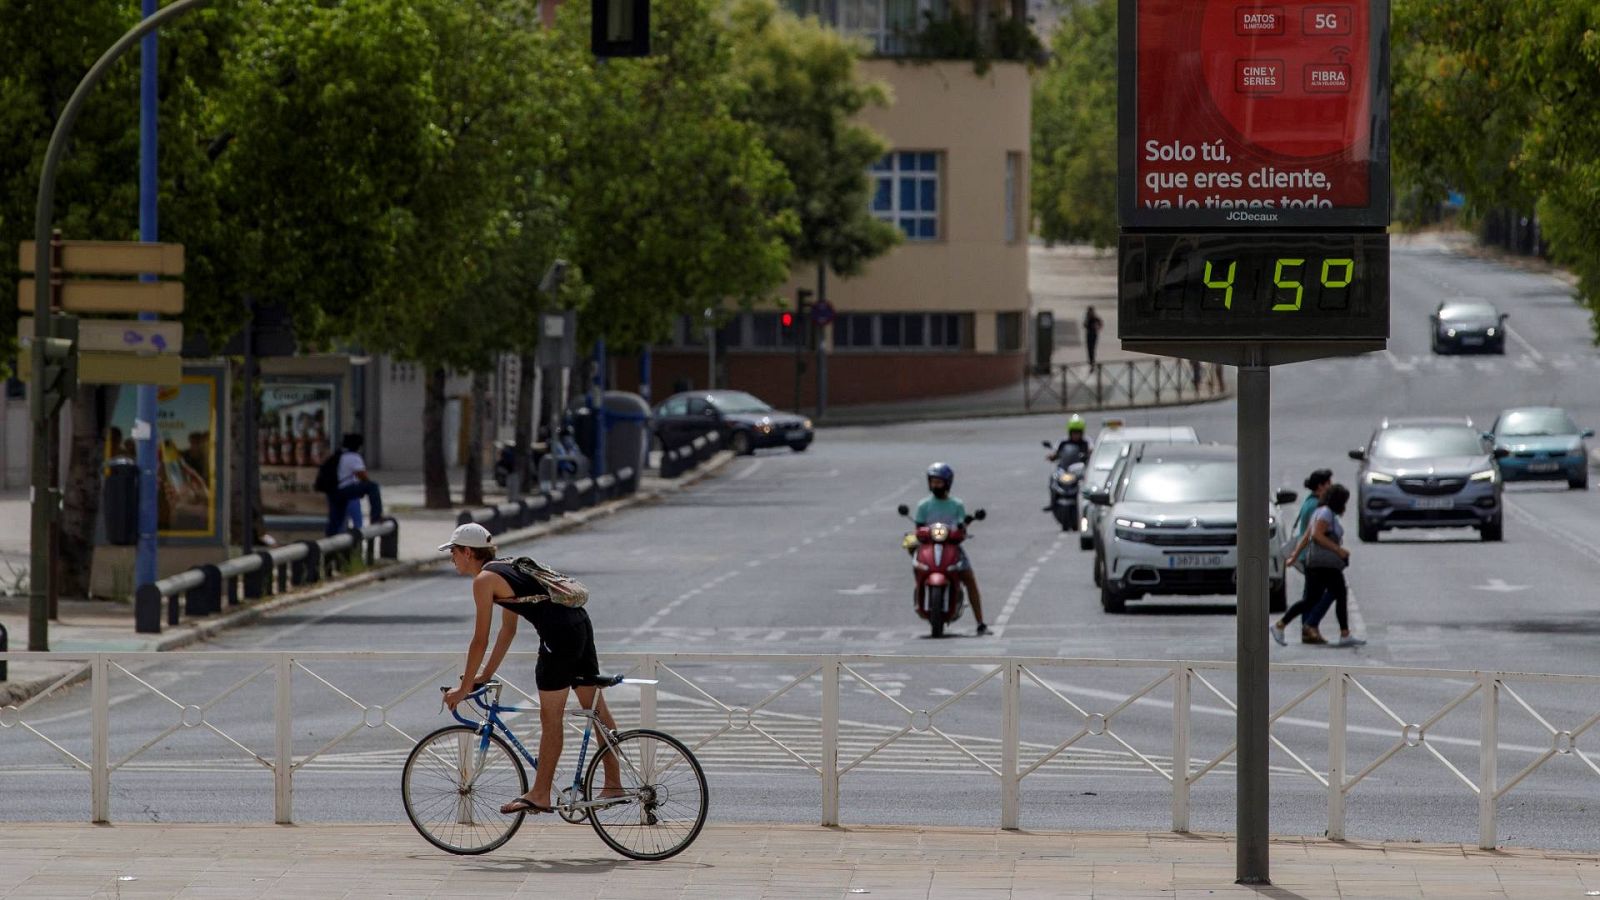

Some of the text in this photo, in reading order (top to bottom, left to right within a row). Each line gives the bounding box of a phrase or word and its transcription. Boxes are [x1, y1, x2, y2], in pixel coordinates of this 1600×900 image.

[1244, 14, 1275, 23] DATOS
[1315, 14, 1337, 28] 5G
[1243, 67, 1276, 76] CINE Y
[1311, 71, 1345, 81] FIBRA
[1243, 77, 1276, 86] SERIES
[1145, 139, 1231, 164] Solo tú,
[1145, 167, 1331, 193] que eres cliente,
[1226, 211, 1278, 221] JCDecaux
